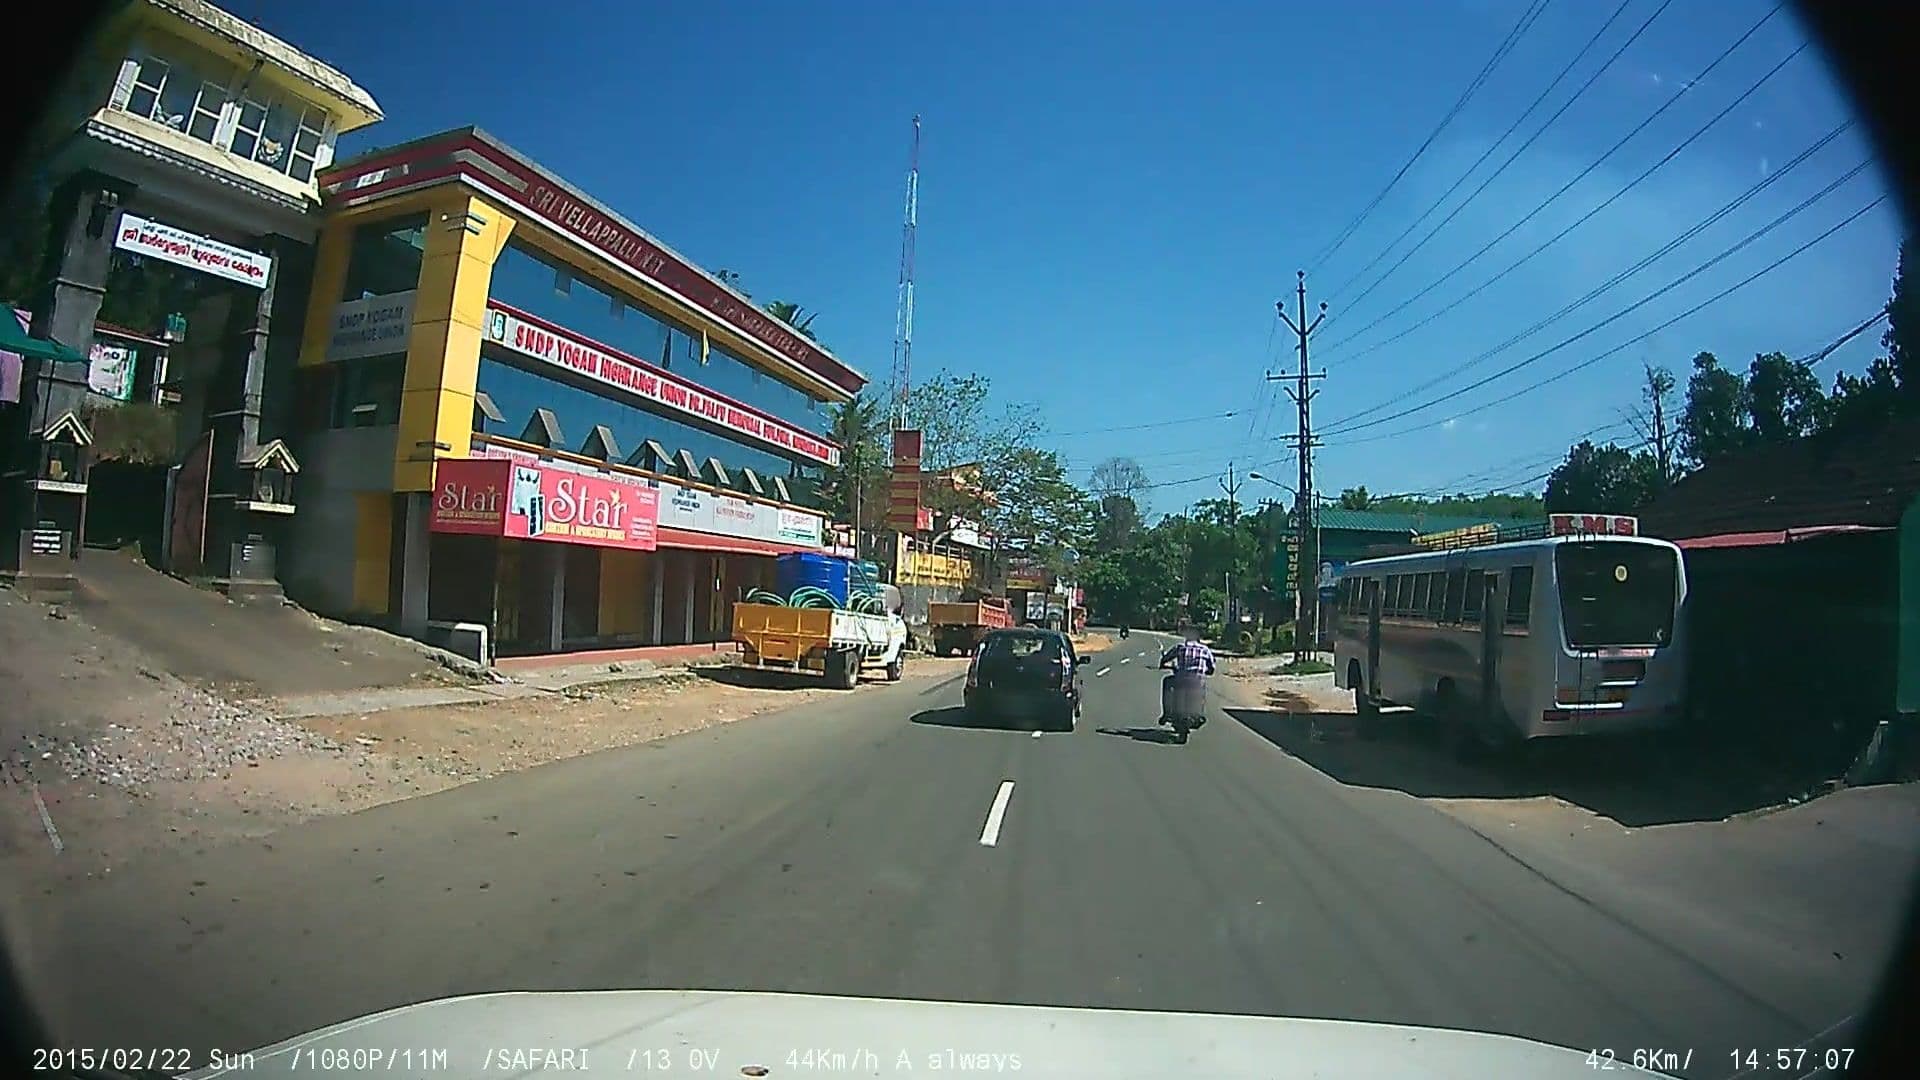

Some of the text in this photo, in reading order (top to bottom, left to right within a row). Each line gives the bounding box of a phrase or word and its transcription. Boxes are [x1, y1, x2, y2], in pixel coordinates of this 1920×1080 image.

[529, 185, 558, 208] SRI
[559, 200, 641, 261] VELLAPPALLI
[515, 325, 554, 357] SNDP
[557, 339, 598, 373] YOGAM
[438, 482, 503, 512] Star
[548, 478, 629, 529] Star
